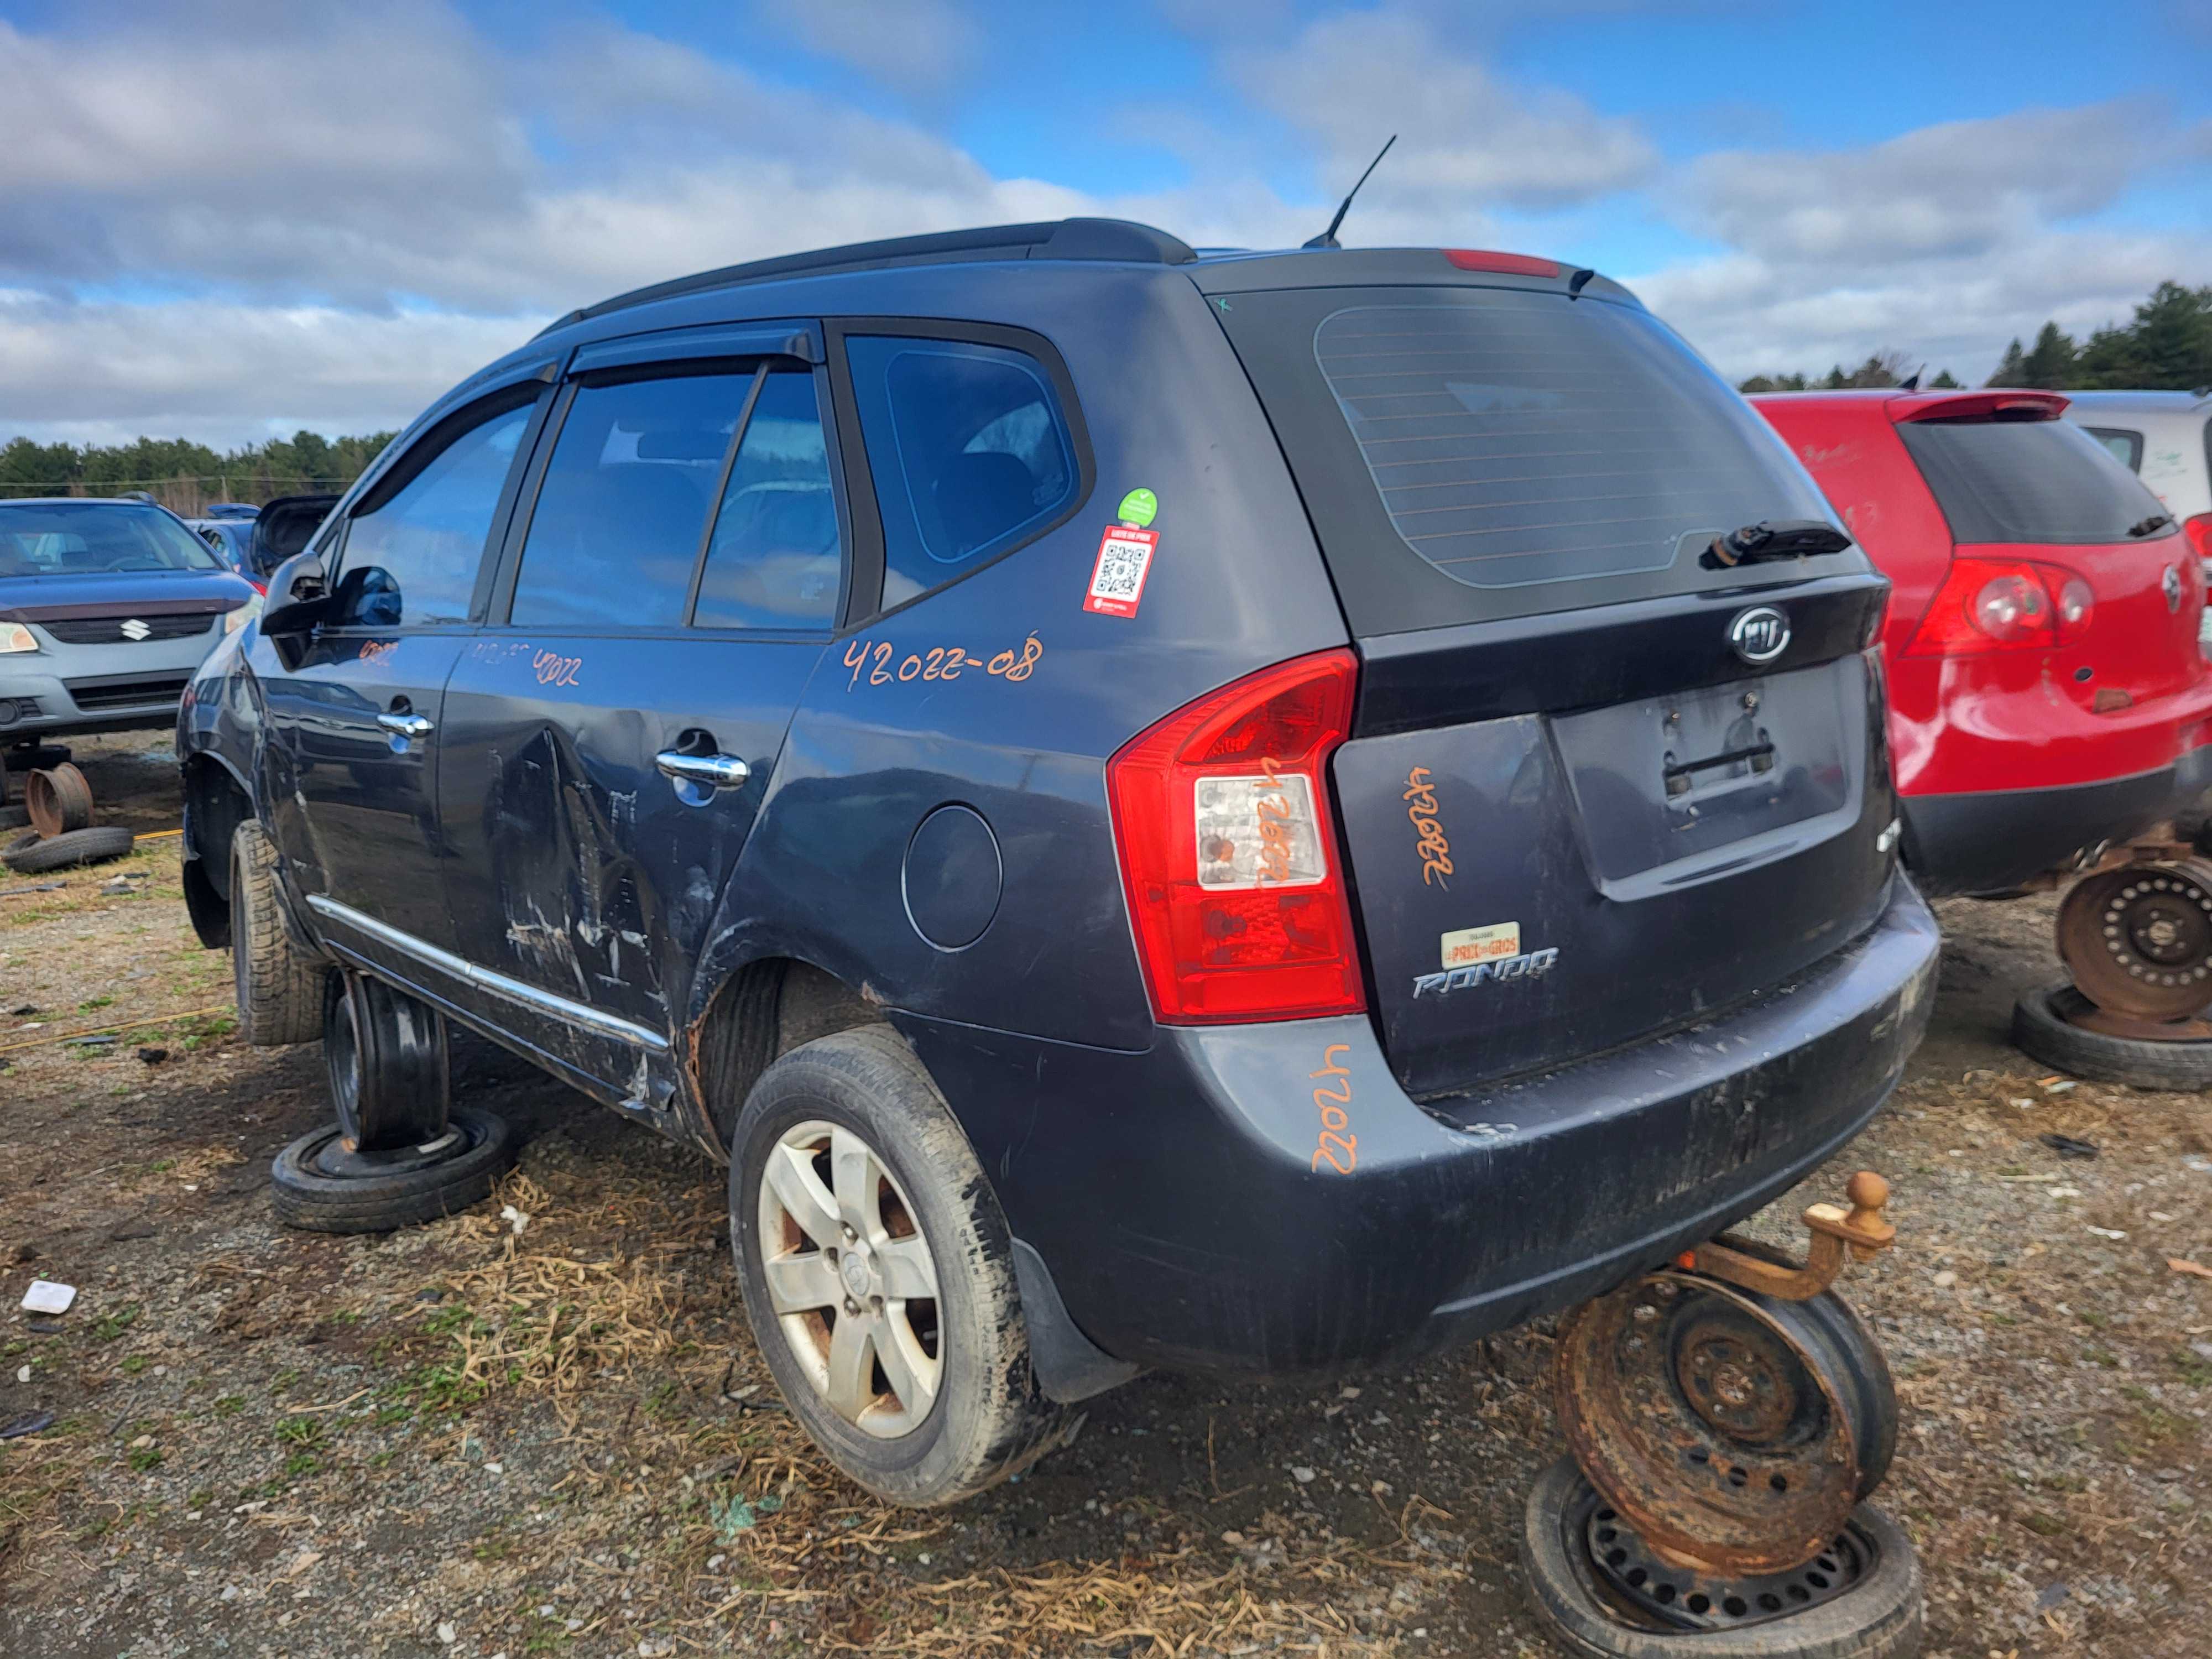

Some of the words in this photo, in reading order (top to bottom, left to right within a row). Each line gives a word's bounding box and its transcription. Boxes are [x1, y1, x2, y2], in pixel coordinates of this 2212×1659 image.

[843, 629, 1044, 692] 42022-08
[1402, 766, 1454, 891] 42022
[1412, 946, 1560, 1000] RONDO
[1309, 1044, 1357, 1175] 42022
